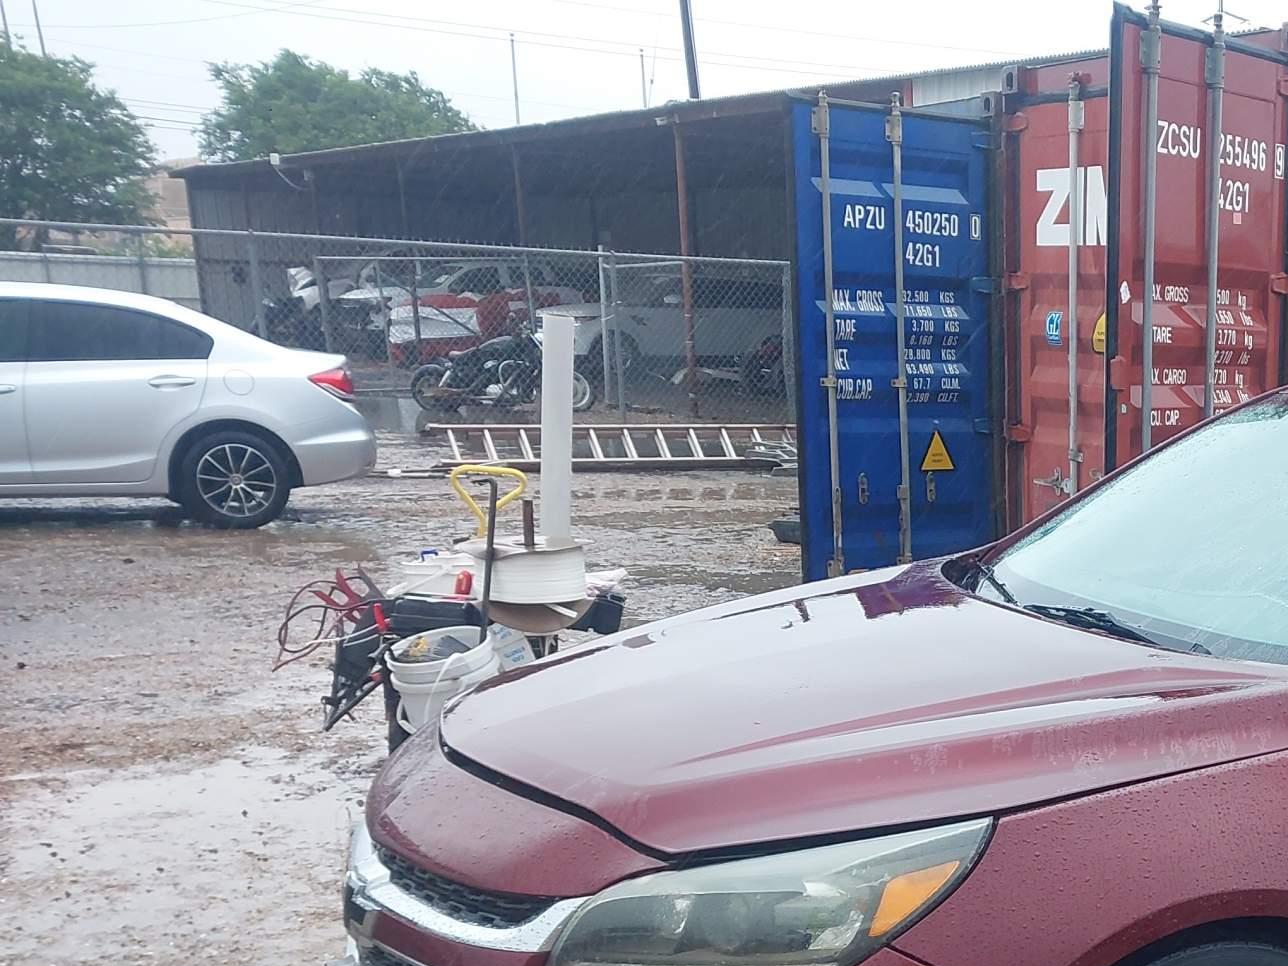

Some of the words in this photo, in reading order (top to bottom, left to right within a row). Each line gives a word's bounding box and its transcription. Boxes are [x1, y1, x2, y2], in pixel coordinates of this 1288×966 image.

[1157, 119, 1201, 159] ZCSU
[1219, 132, 1267, 172] 255496
[1276, 146, 1284, 177] 9
[843, 204, 886, 230] APZU
[905, 210, 959, 237] 450250
[905, 242, 940, 267] 42G1
[832, 288, 856, 311] MAX.
[856, 289, 885, 312] GROSS
[902, 290, 929, 303] 32.500
[940, 291, 955, 303] KGS
[1152, 283, 1163, 301] AX.
[1164, 285, 1189, 303] GROSS
[1216, 289, 1230, 305] 500
[1238, 290, 1247, 310] kg
[941, 305, 958, 318] LBS
[1239, 311, 1254, 326] lbs
[835, 319, 857, 340] TARE
[911, 319, 934, 332] 3.700
[944, 320, 960, 333] KGS
[942, 335, 959, 346] LBS
[1152, 326, 1173, 344] TARE
[1218, 329, 1237, 346] 3.770
[1244, 330, 1253, 350] kg
[904, 348, 931, 360] 28.800
[941, 348, 956, 361] KGS
[1237, 351, 1251, 365] lbs
[943, 363, 960, 375] LBS
[1163, 368, 1187, 385] CARGO
[913, 377, 931, 390] 67.7
[1234, 370, 1244, 389] kg
[1164, 409, 1182, 426] CAP.
